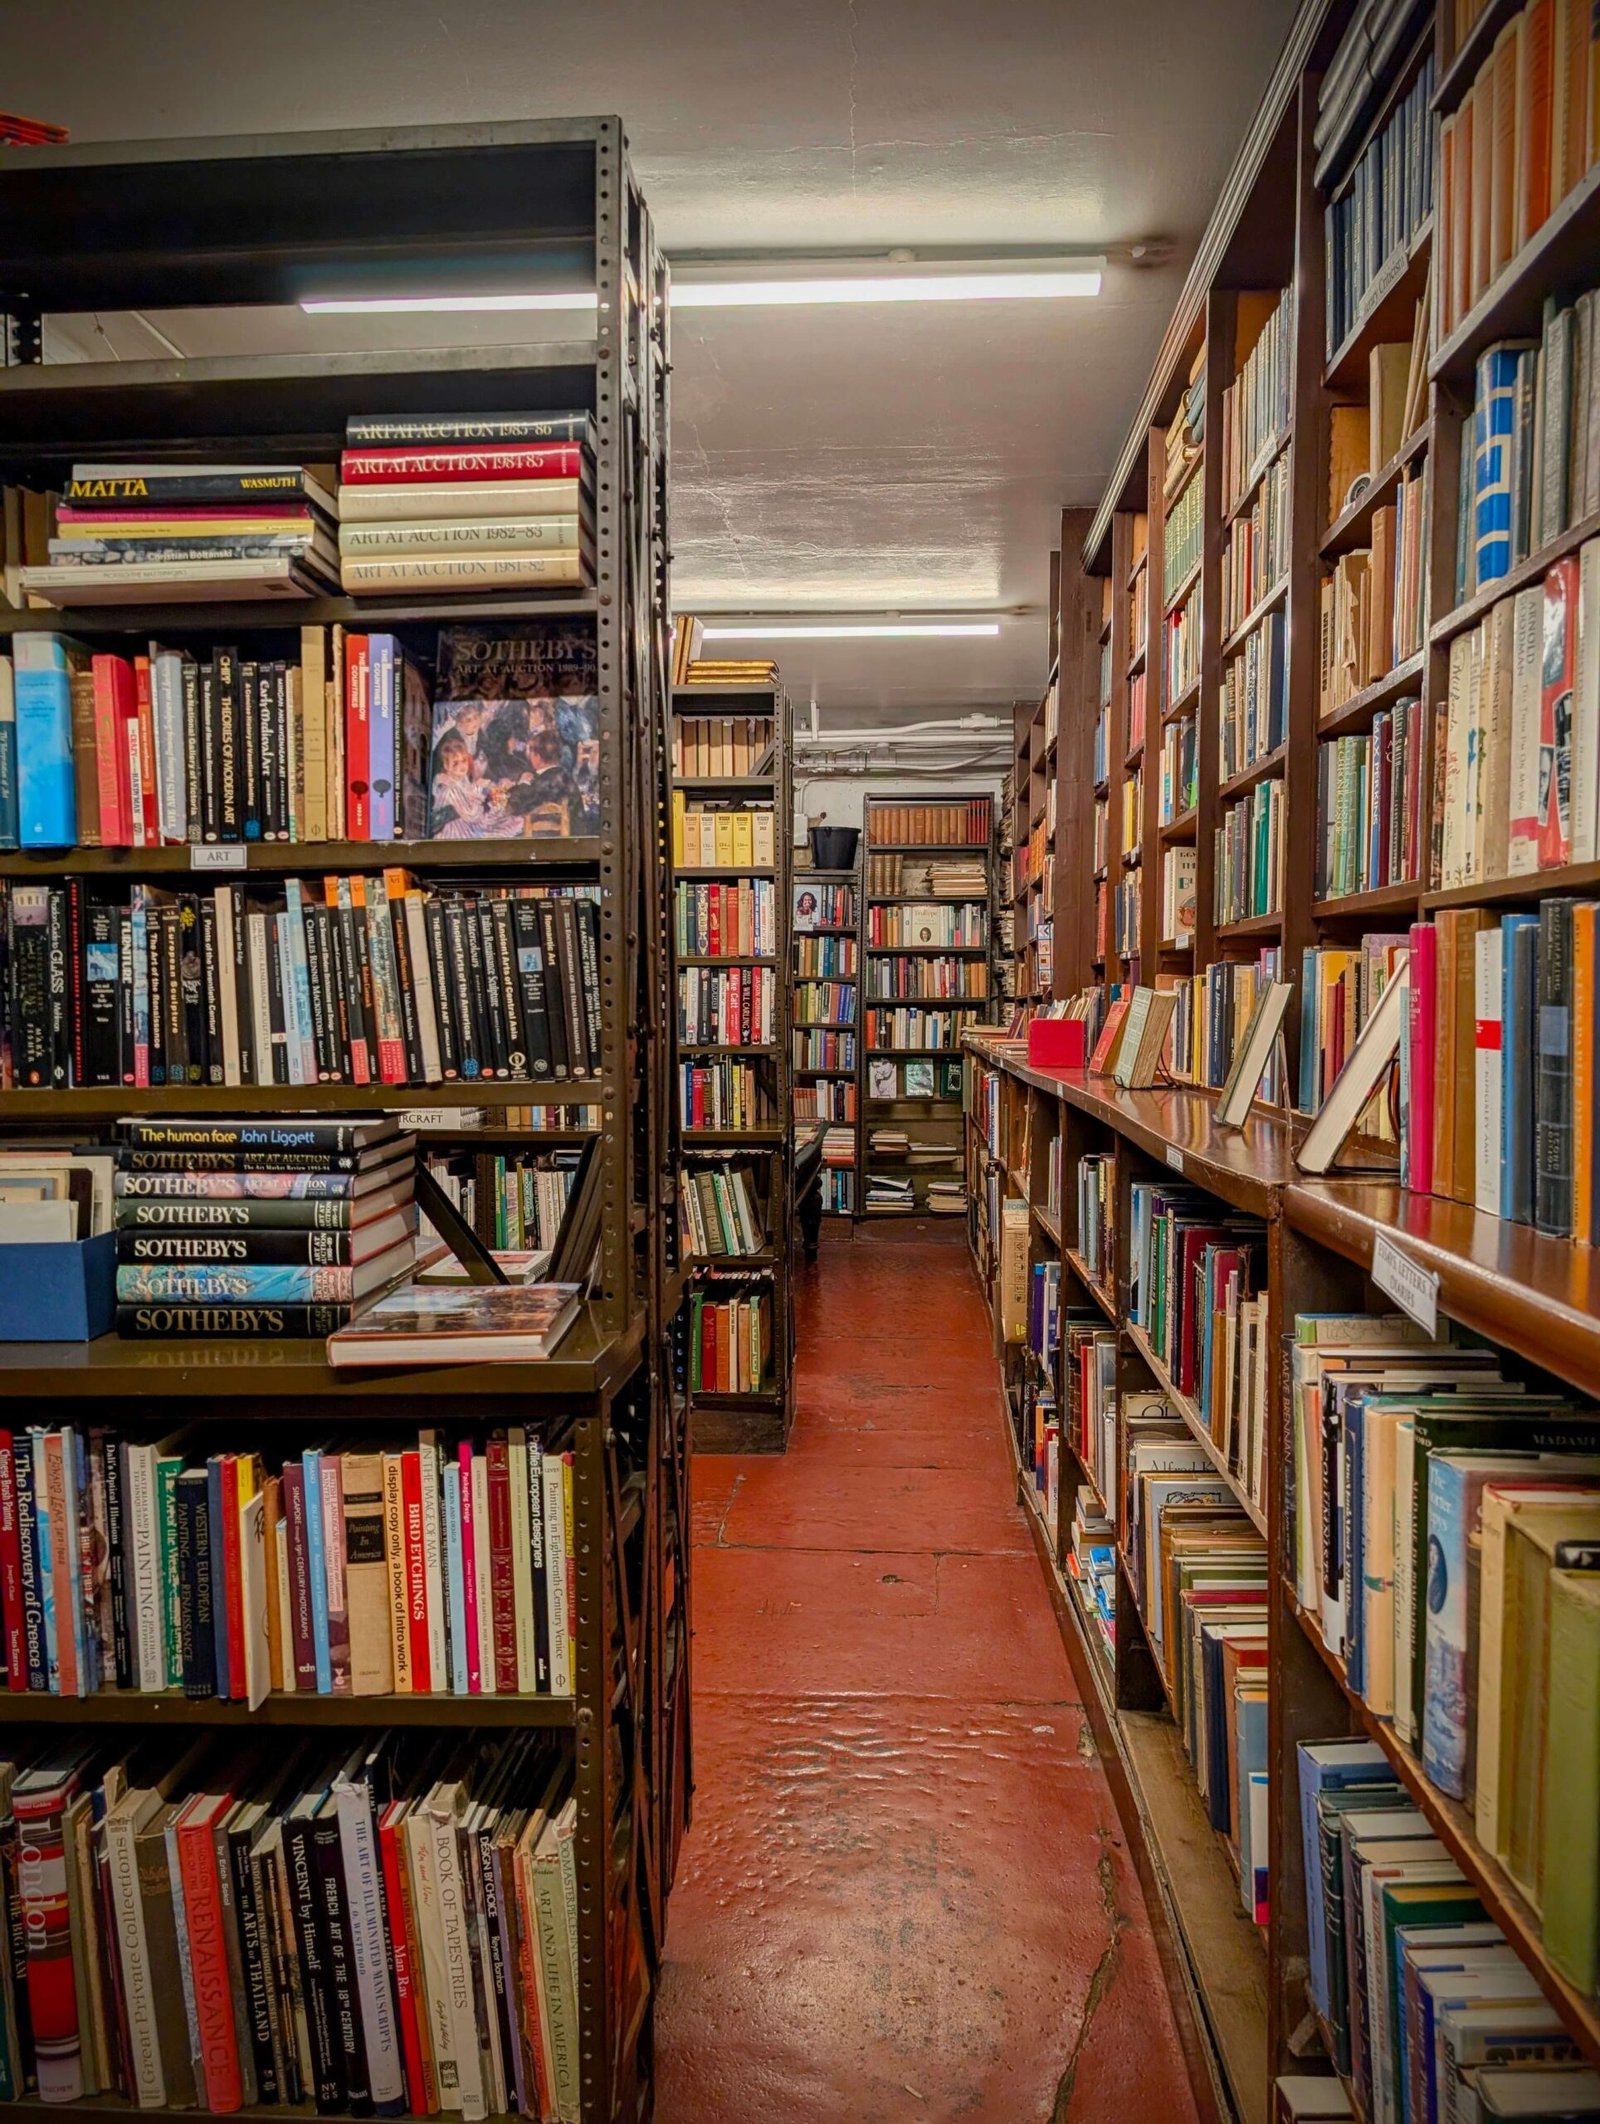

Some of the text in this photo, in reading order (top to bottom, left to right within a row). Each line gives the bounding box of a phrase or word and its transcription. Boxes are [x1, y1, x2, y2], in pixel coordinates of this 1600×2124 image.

[352, 459, 385, 474] ART
[387, 459, 408, 473] AT
[411, 456, 487, 472] AUCTION
[70, 476, 296, 498] MATTA WASMUTH
[147, 548, 232, 561] Christian Boltanski
[350, 526, 542, 545] ART AT AUCTION 1982-83
[457, 640, 597, 660] SOTHEBY'S
[1516, 595, 1537, 676] ARNOLD GOODMAN
[219, 656, 236, 824] CHIPP THEORIES OF MODERN ART
[1372, 720, 1380, 825] MAX PERKINS
[207, 851, 231, 862] ART
[432, 916, 441, 930] THE
[466, 916, 480, 967] Watercolours
[543, 915, 556, 966] Romantic Art
[50, 896, 64, 993] Phaidon Guide to GLASS
[121, 922, 133, 984] FURNITURE
[433, 932, 443, 959] RUSSIAN
[149, 933, 162, 1048] The Art of the Renaissance
[168, 927, 179, 1033] European Sculpture
[306, 919, 324, 1037] CHARLES RENNIE MACKINTOSH
[435, 961, 447, 1001] EXPERIMENT
[497, 922, 519, 1039] Ancient Arts of Central Asia
[579, 915, 597, 1052] THE ARCHAIC PERIOD JOHN BOARDMAN
[729, 974, 740, 1008] Mike Catt
[441, 1010, 450, 1024] ART
[742, 987, 751, 1028] WILL CARLING
[754, 998, 762, 1029] ROBINSON
[140, 1128, 315, 1146] The human face John Liggett
[399, 1114, 443, 1124] IRCRAFT
[132, 1152, 235, 1169] SOTHEBY'S
[125, 1178, 235, 1194] SOTHEBY'S
[137, 1207, 249, 1223] SOTHEBY'S
[134, 1240, 247, 1258] SOTHEBY'S
[137, 1279, 248, 1294] SOTHEBY'S
[136, 1310, 284, 1331] SOTHEBY'S
[1281, 1350, 1293, 1464] MAEVE BRENNAN
[106, 1472, 118, 1503] Optical
[422, 1447, 439, 1567] IN THE IMAGE OF MAN
[528, 1435, 544, 1567] Profile European designers
[547, 1482, 560, 1521] Painting
[108, 1507, 121, 1544] Illusions
[550, 1523, 560, 1533] in
[15, 1455, 42, 1667] The Rediscovery of Greece
[137, 1530, 153, 1618] PAINTING
[386, 1466, 409, 1671] display copy only, a book of Intro work
[408, 1503, 425, 1620] BIRD ETCHINGS
[141, 1621, 151, 1667] STEPHENSON
[147, 1621, 157, 1660] JONATHAN
[553, 1630, 565, 1659] Venice
[19, 1819, 57, 1951] London
[240, 1895, 250, 1909] THE
[291, 1834, 320, 1970] VINCENT by Himself
[243, 1912, 258, 1948] ARTS
[434, 1818, 467, 2008] A BOOK OF TAPESTRIES
[479, 1837, 505, 1994] DESIGN BY CHOICE Reyner Banham
[248, 1950, 257, 1961] OF
[354, 1820, 390, 2054] THE ART OF ILLUMINATED MANUSCRIPTS
[117, 1838, 156, 2084] Great Private Collections
[324, 1877, 355, 2054] FRENCH ART OF THE 18TH CENTURY
[394, 1945, 407, 1973] Man
[193, 1897, 230, 2076] RENAISSANCE
[250, 1963, 269, 2042] THAILAND
[539, 1888, 570, 2089] ART AND LIFE IN AMERICA
